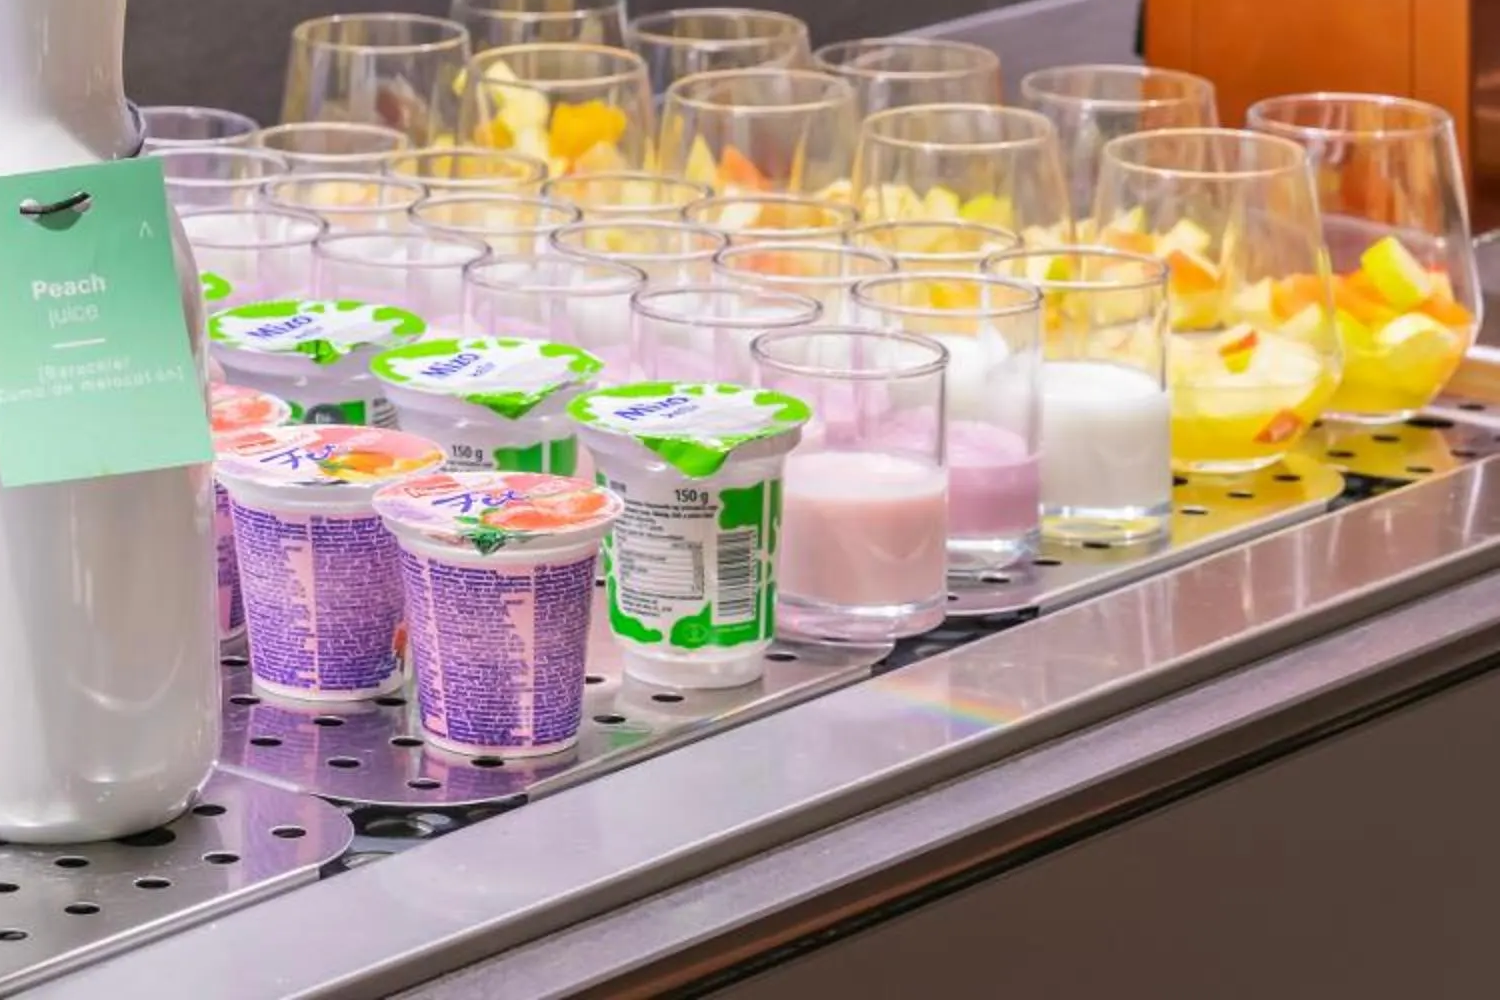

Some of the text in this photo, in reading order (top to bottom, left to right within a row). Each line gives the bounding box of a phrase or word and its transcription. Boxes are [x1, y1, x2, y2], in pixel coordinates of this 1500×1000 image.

[31, 273, 107, 300] Peach
[48, 303, 100, 329] juice
[612, 396, 690, 421] Mizo
[452, 444, 484, 462] 150 g
[675, 488, 710, 505] 150 g
